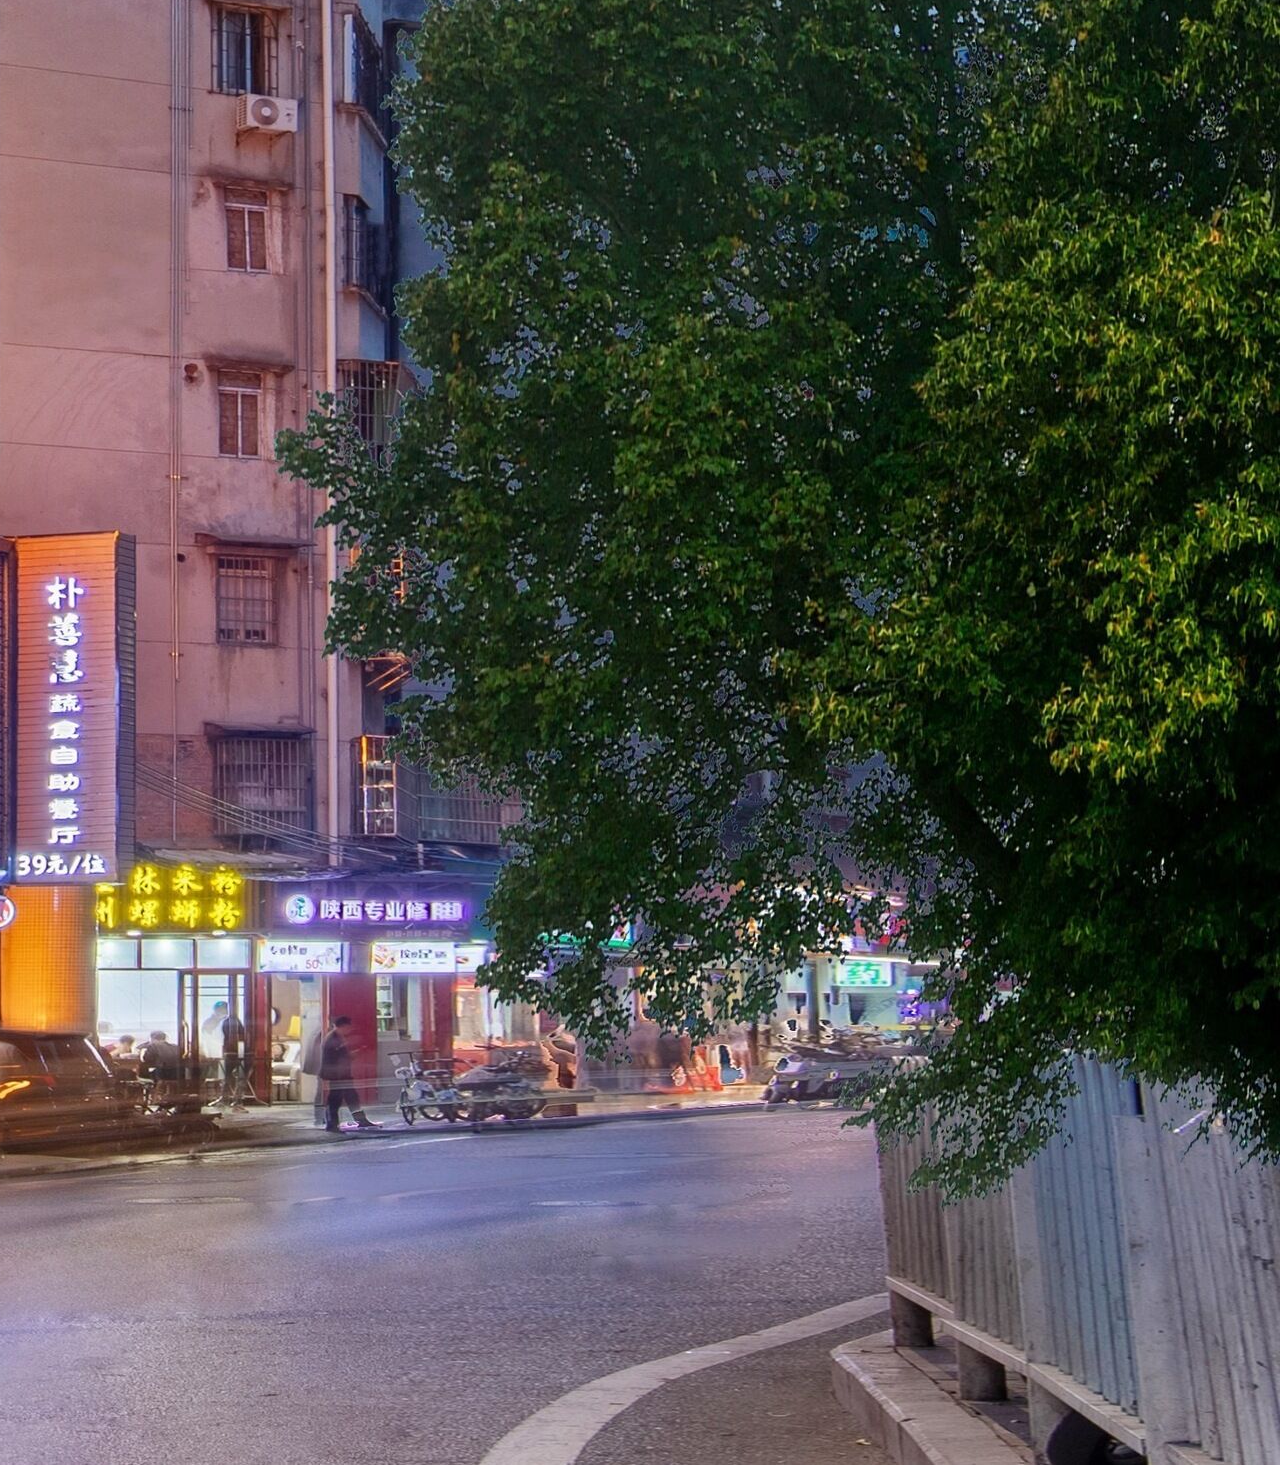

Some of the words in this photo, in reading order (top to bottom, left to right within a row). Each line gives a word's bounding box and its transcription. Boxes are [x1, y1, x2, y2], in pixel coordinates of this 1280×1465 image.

[47, 694, 81, 845] 蔬食自助餐厅
[16, 854, 106, 876] 39元/位
[847, 961, 882, 982] 药
